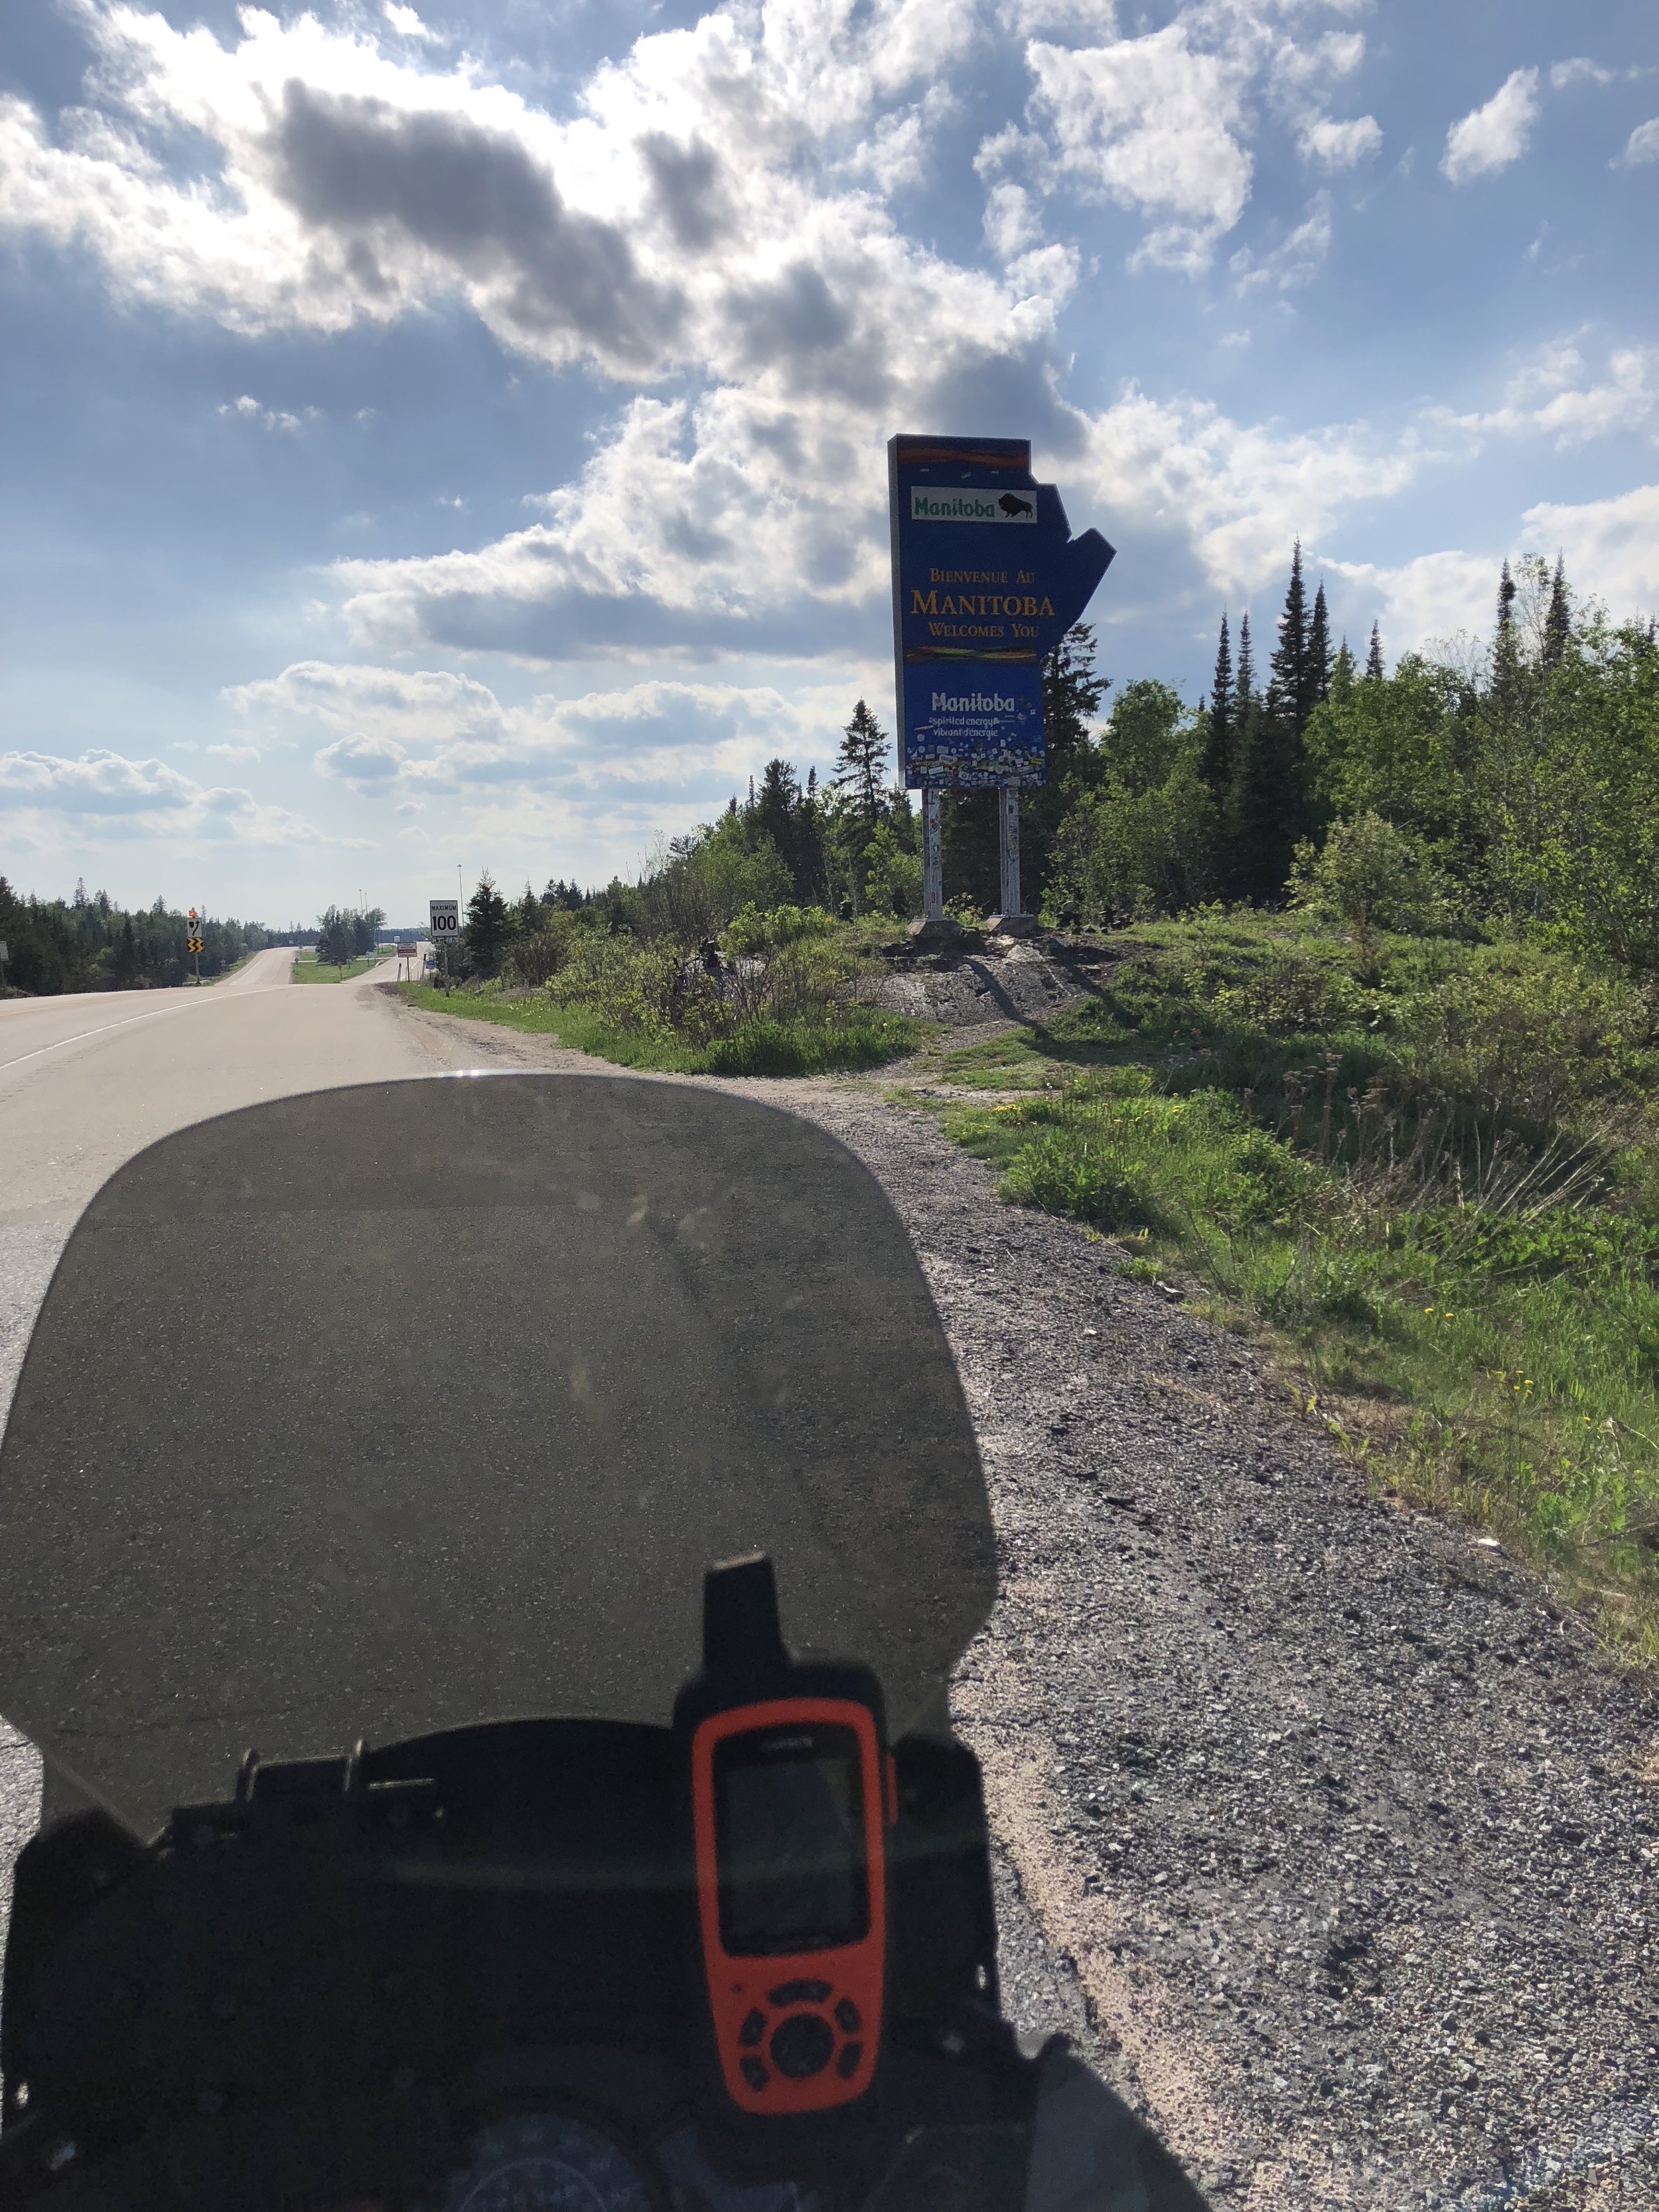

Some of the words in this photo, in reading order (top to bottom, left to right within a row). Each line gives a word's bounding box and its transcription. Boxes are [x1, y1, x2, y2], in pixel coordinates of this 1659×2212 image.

[914, 497, 995, 518] Manitoba
[930, 568, 1008, 583] BIENVENUE
[1017, 569, 1035, 584] AU
[911, 589, 1055, 617] MANITOBA
[930, 623, 1005, 638] WELCOMES
[1012, 624, 1040, 638] YOU
[932, 692, 1015, 711] Manitoba
[933, 717, 964, 727] spirited
[966, 719, 993, 729] energy
[933, 727, 962, 737] vibrant
[432, 915, 457, 930] 100
